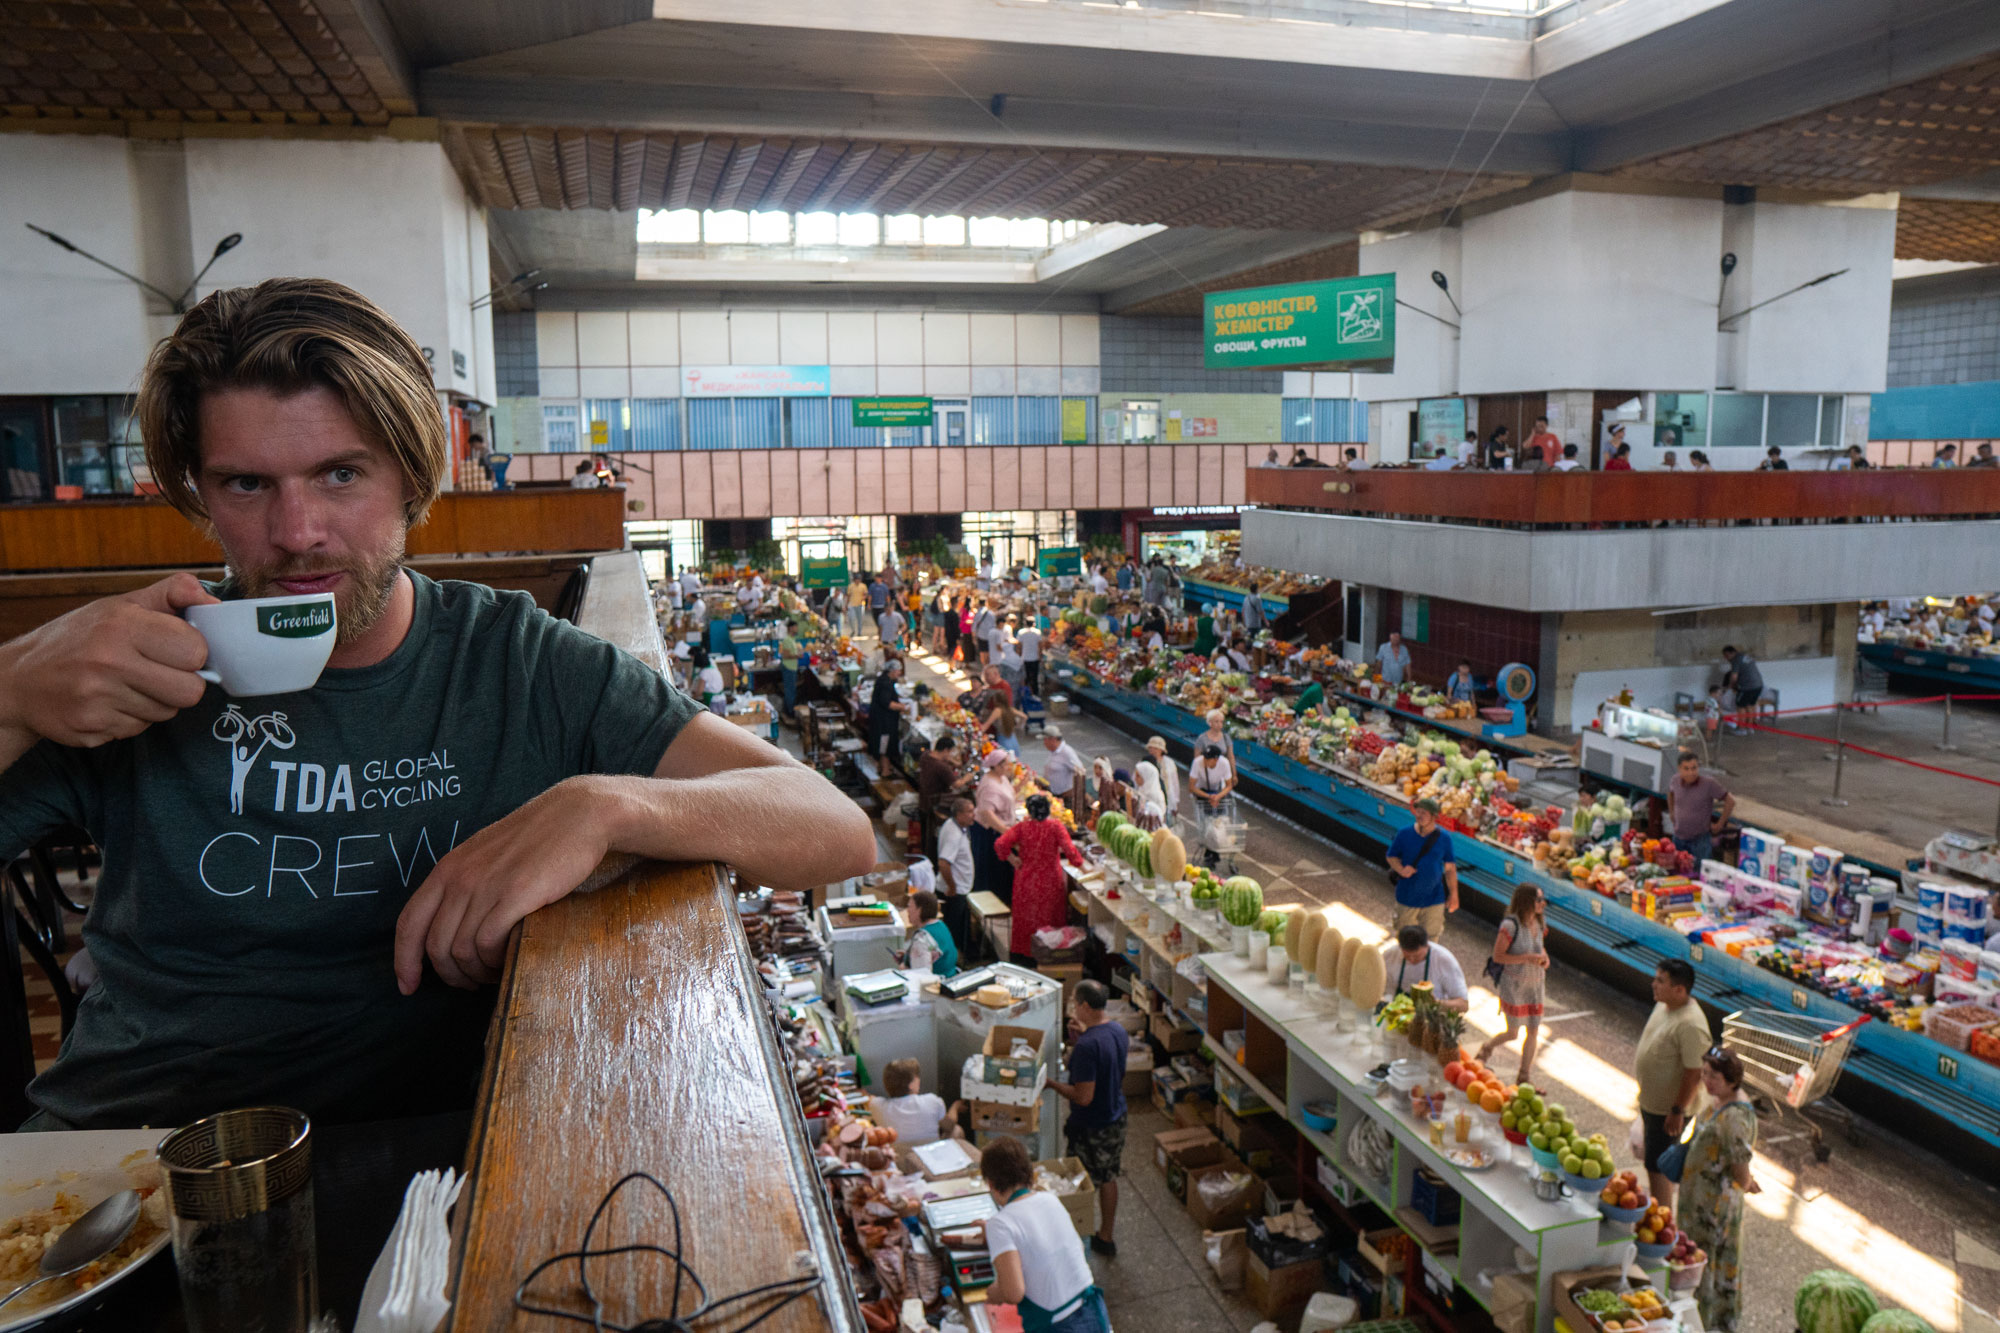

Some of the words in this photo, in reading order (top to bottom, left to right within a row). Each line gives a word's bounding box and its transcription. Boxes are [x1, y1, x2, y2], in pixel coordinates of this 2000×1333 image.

[1214, 296, 1318, 320] КӨКӨНІСТЕР,
[1215, 315, 1294, 336] ЖЕМІСТЕР
[1214, 340, 1258, 354] ОВОЩИ,
[1261, 337, 1306, 349] ФРУКТЫ
[269, 607, 329, 631] Greenfield
[270, 761, 356, 812] TDA
[361, 775, 461, 809] CYCLING
[199, 820, 459, 899] CREW
[1940, 1056, 1957, 1078] 171
